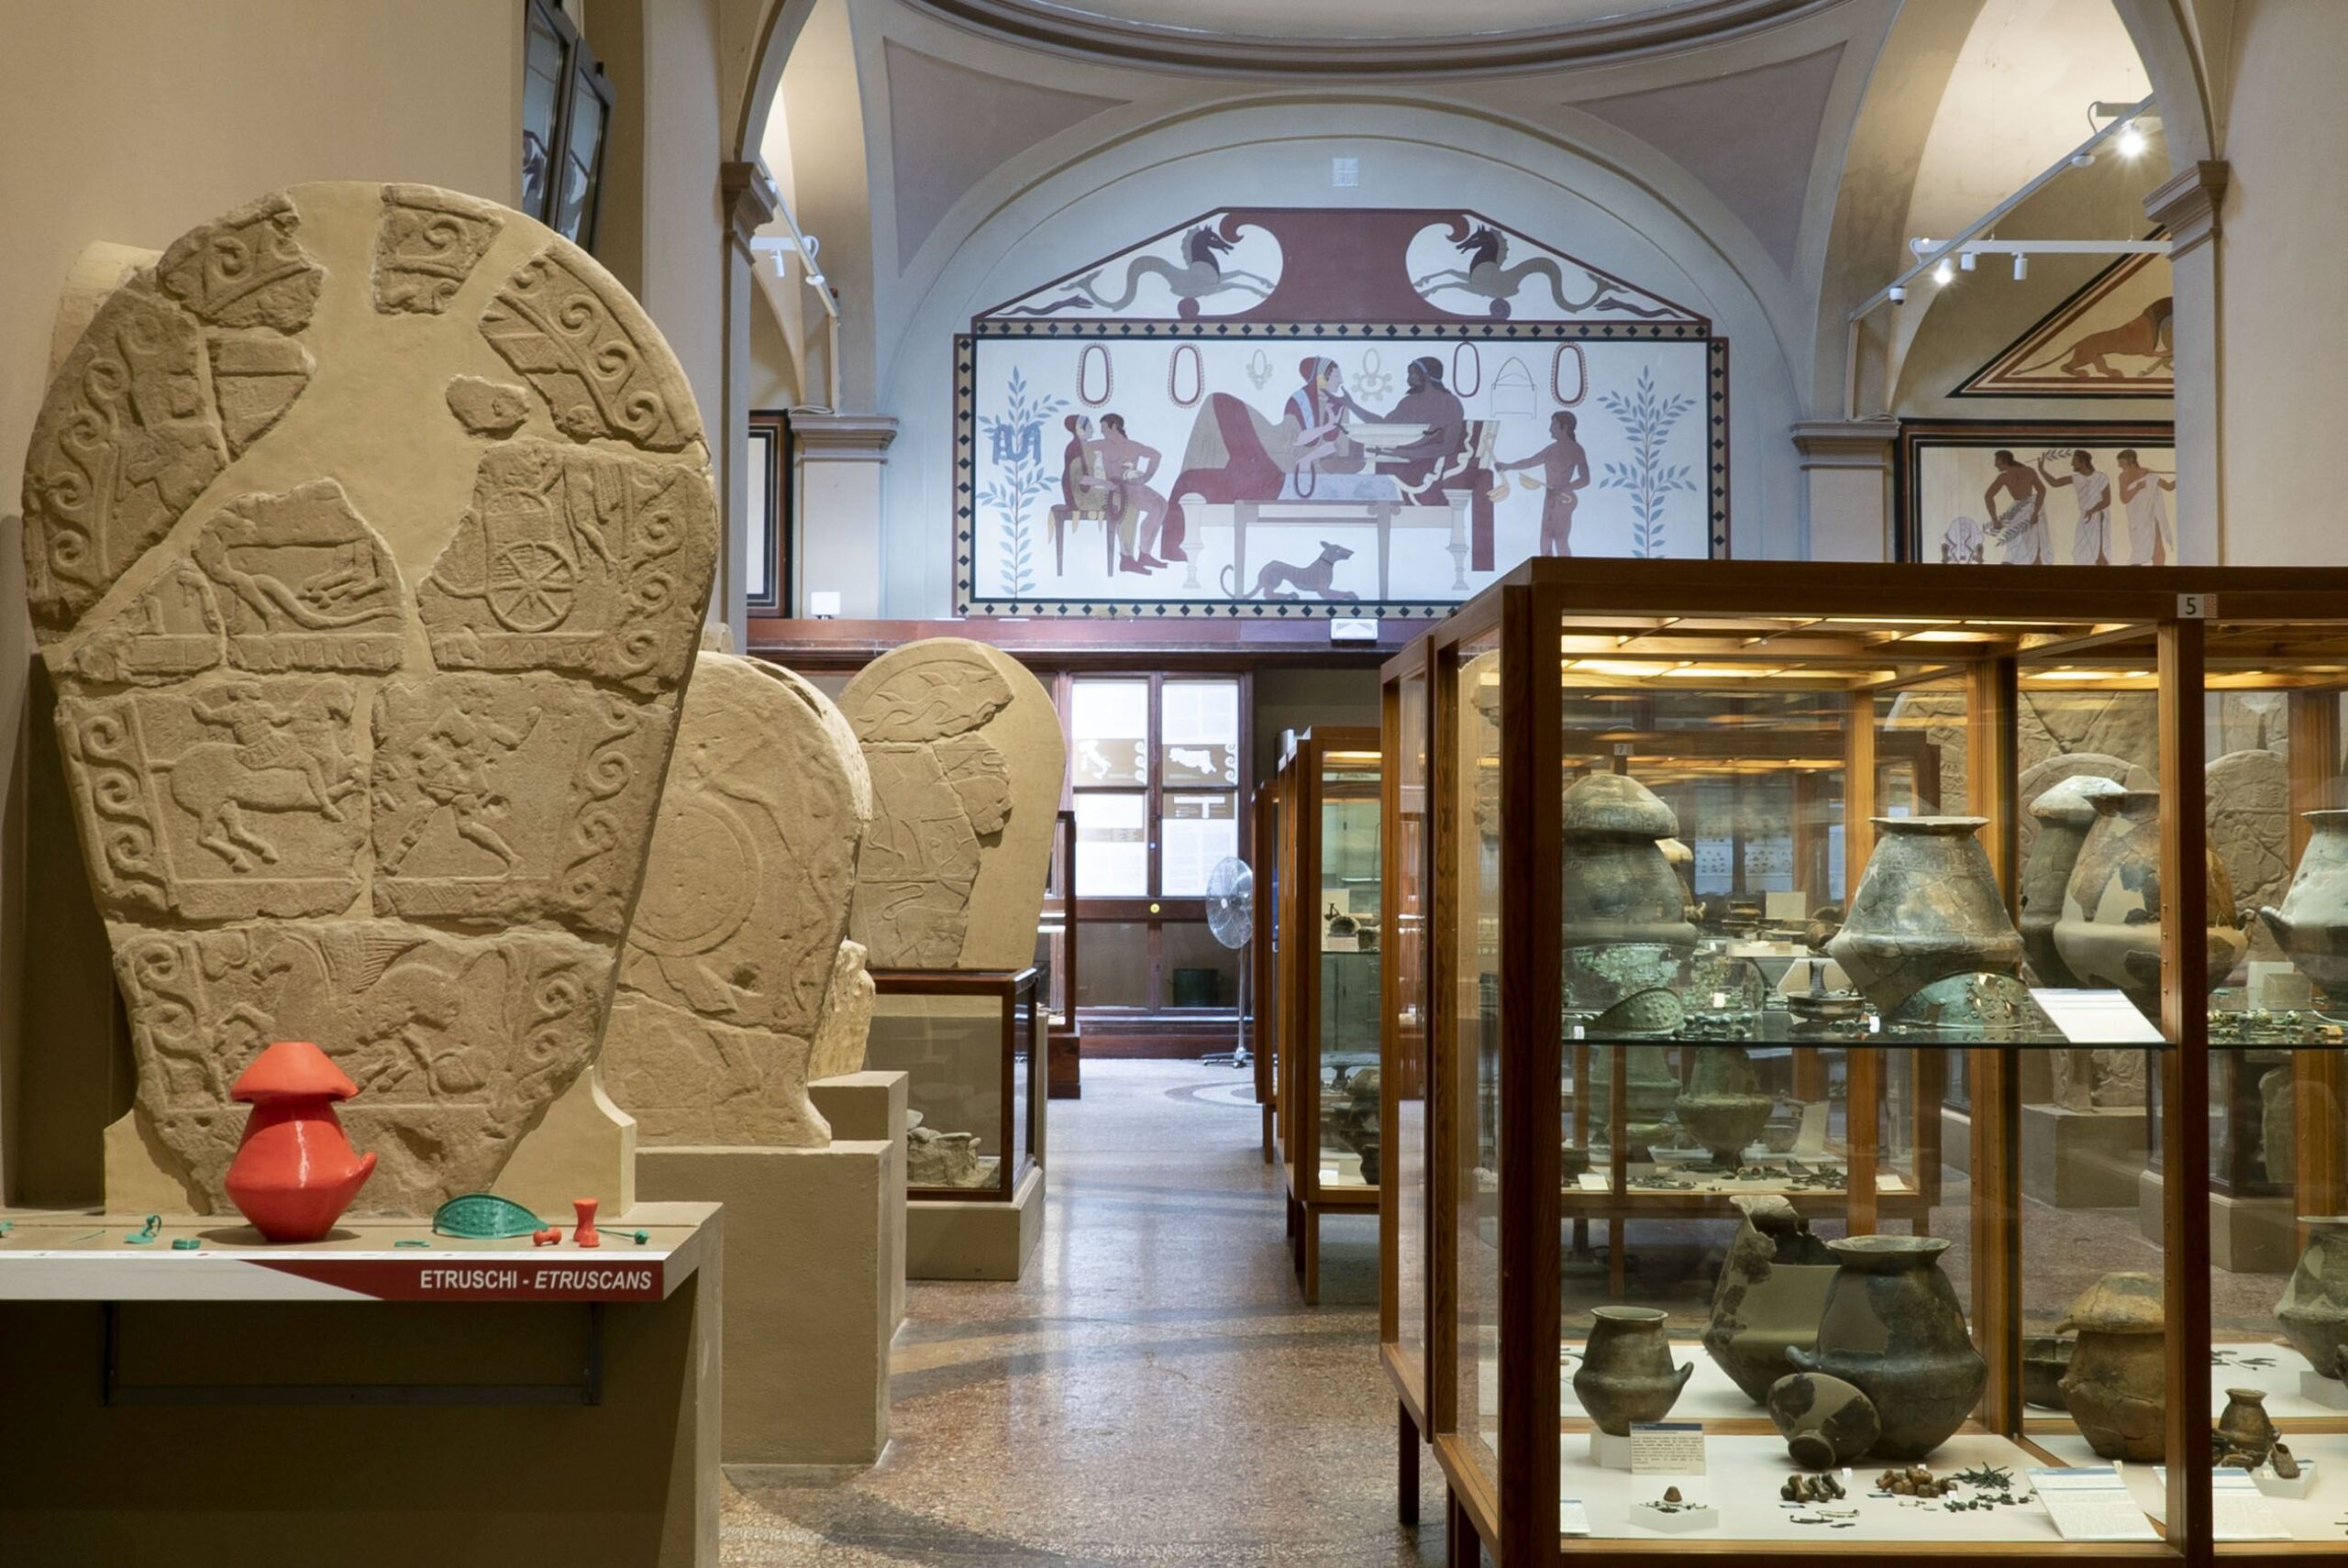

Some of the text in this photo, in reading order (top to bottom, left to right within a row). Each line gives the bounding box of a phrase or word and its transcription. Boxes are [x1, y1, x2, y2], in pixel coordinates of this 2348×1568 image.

[2185, 596, 2197, 616] 5
[419, 1269, 518, 1289] ETRUSCHI
[534, 1270, 653, 1290] ETRUSCANS
